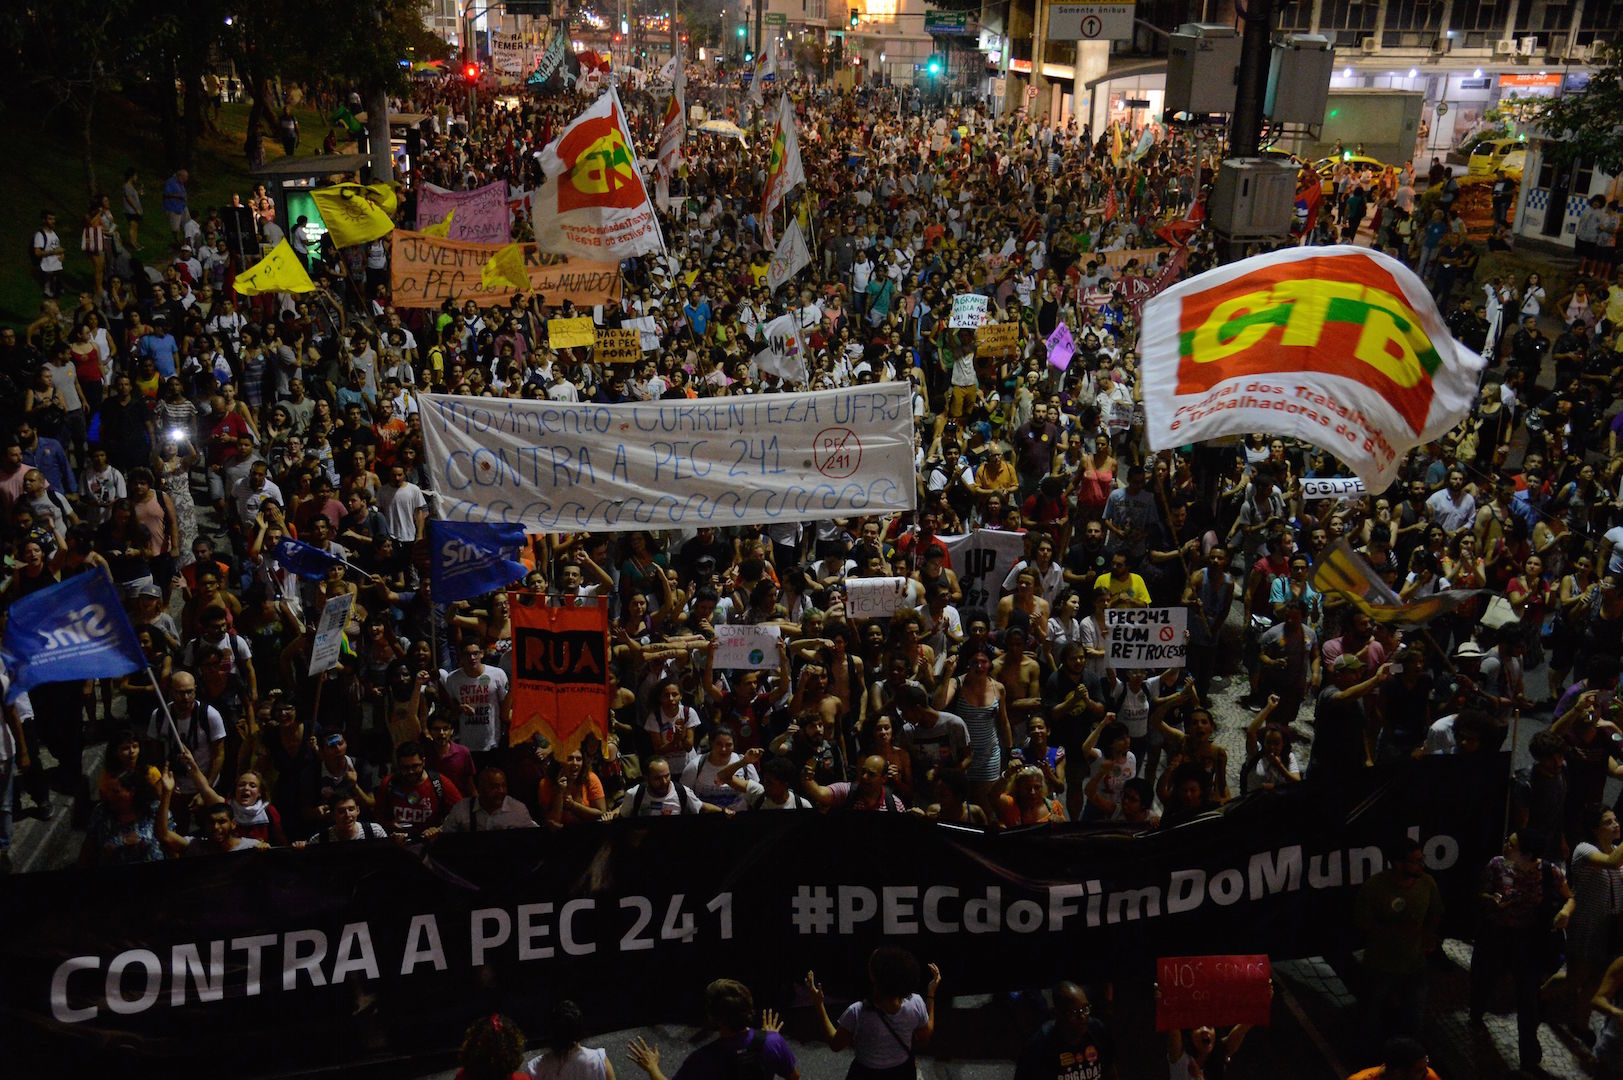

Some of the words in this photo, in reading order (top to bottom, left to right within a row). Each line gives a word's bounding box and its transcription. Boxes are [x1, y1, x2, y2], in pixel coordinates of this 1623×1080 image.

[1058, 6, 1094, 14] Somente
[422, 268, 465, 302] PEC
[595, 339, 615, 349] TER
[618, 339, 636, 348] PEC
[619, 329, 636, 338] VAI
[1192, 279, 1433, 388] CTB
[1174, 382, 1239, 418] Central
[1245, 381, 1284, 394] dos
[434, 399, 612, 437] Movimento
[834, 393, 906, 425] UFRJ
[1170, 420, 1182, 431] e
[1190, 395, 1331, 427] Trabalhadoras
[1335, 422, 1357, 443] do
[823, 437, 851, 452] PEC
[446, 444, 596, 490] CONTRA
[612, 443, 629, 484] A
[651, 440, 712, 481] PEC
[728, 435, 787, 477] 241
[826, 454, 850, 469] 241
[1304, 480, 1366, 495] GOLPE
[965, 548, 997, 581] UP
[720, 626, 769, 637] CONTRA
[727, 637, 745, 648] PEC
[524, 635, 601, 676] RUA
[393, 806, 432, 823] CCCP
[50, 921, 381, 1024] CONTRA
[399, 912, 449, 972] A
[470, 896, 597, 967] PEC
[618, 891, 734, 952] 241
[791, 825, 1460, 935] #PECdoFimDoMuno
